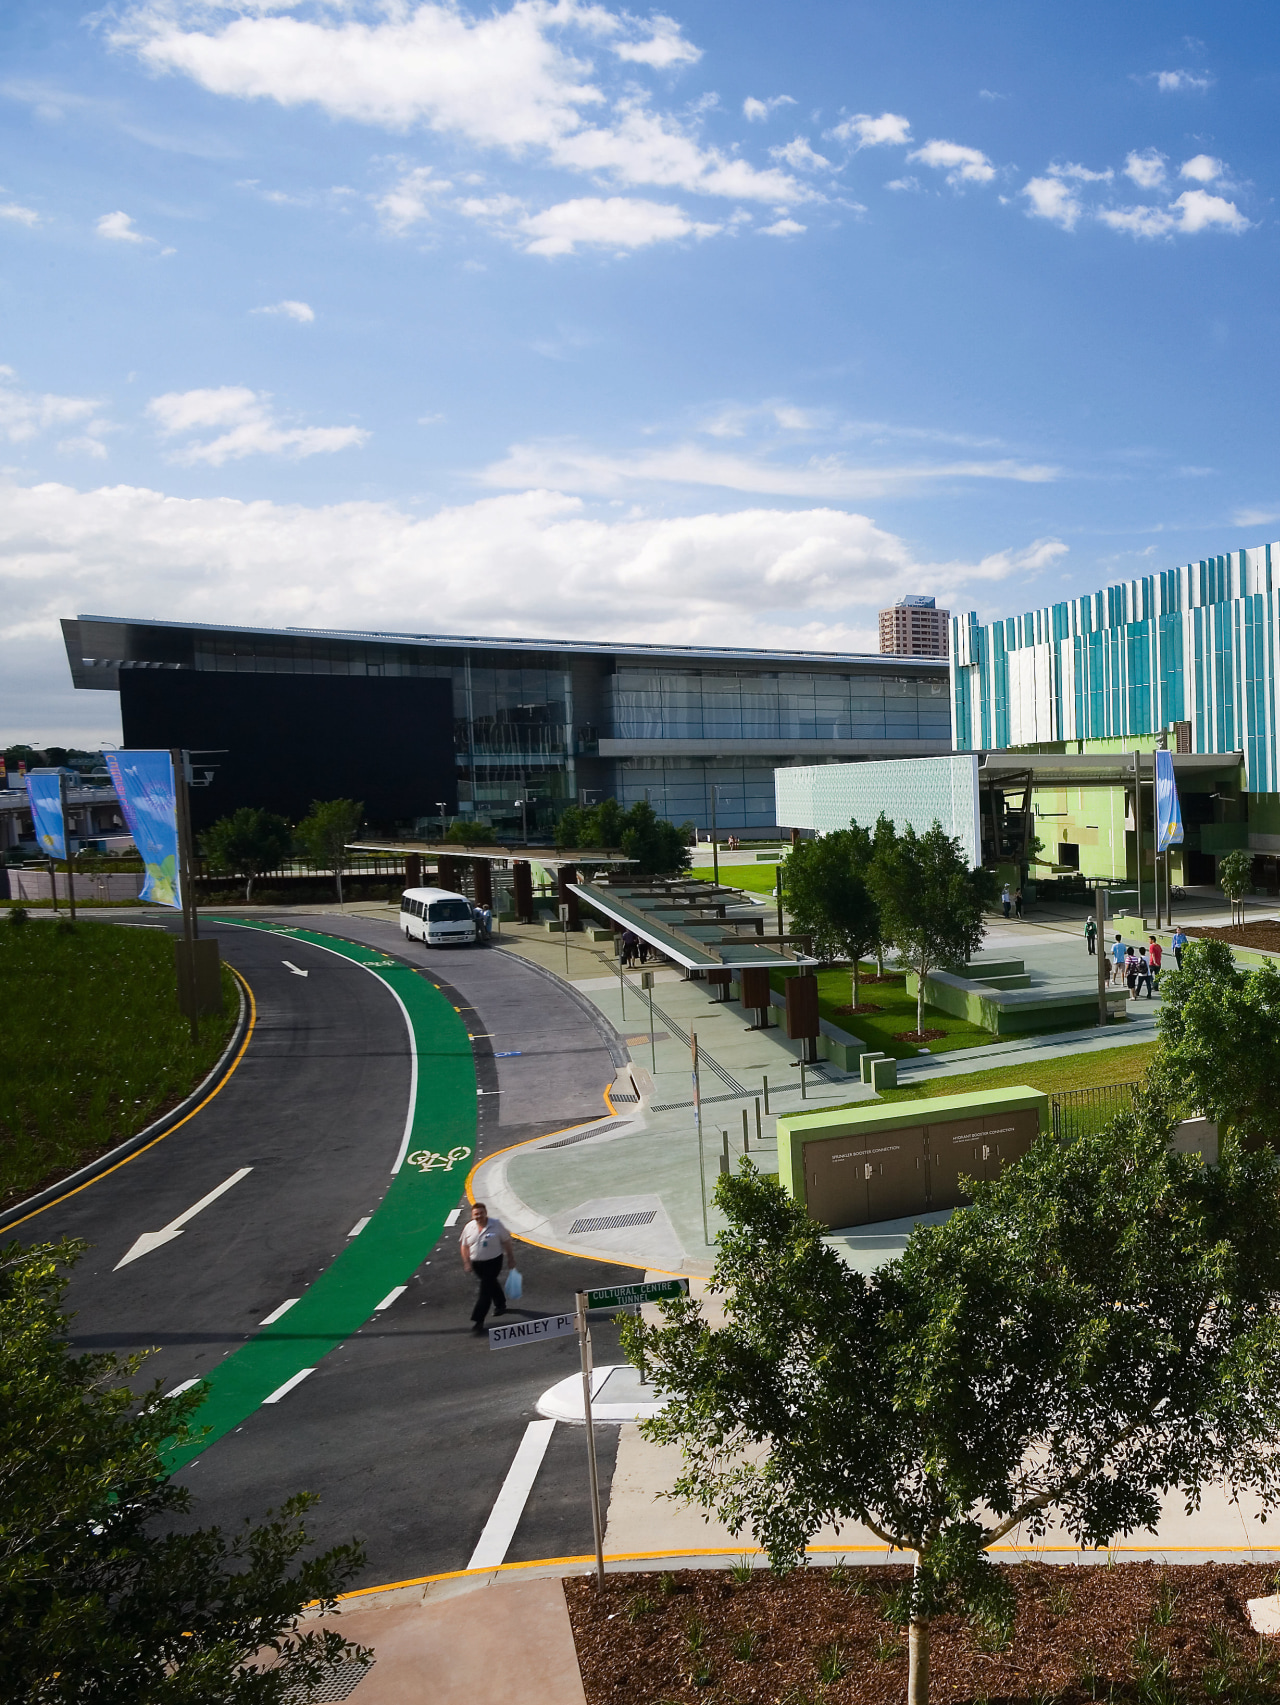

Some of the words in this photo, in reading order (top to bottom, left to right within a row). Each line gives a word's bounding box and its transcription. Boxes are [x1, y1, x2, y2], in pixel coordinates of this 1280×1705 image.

[592, 1286, 637, 1300] CULTURAL
[640, 1281, 673, 1294] CENTRE
[616, 1293, 650, 1305] TUNNEL
[493, 1320, 549, 1341] STANLEY
[557, 1316, 571, 1330] PL
